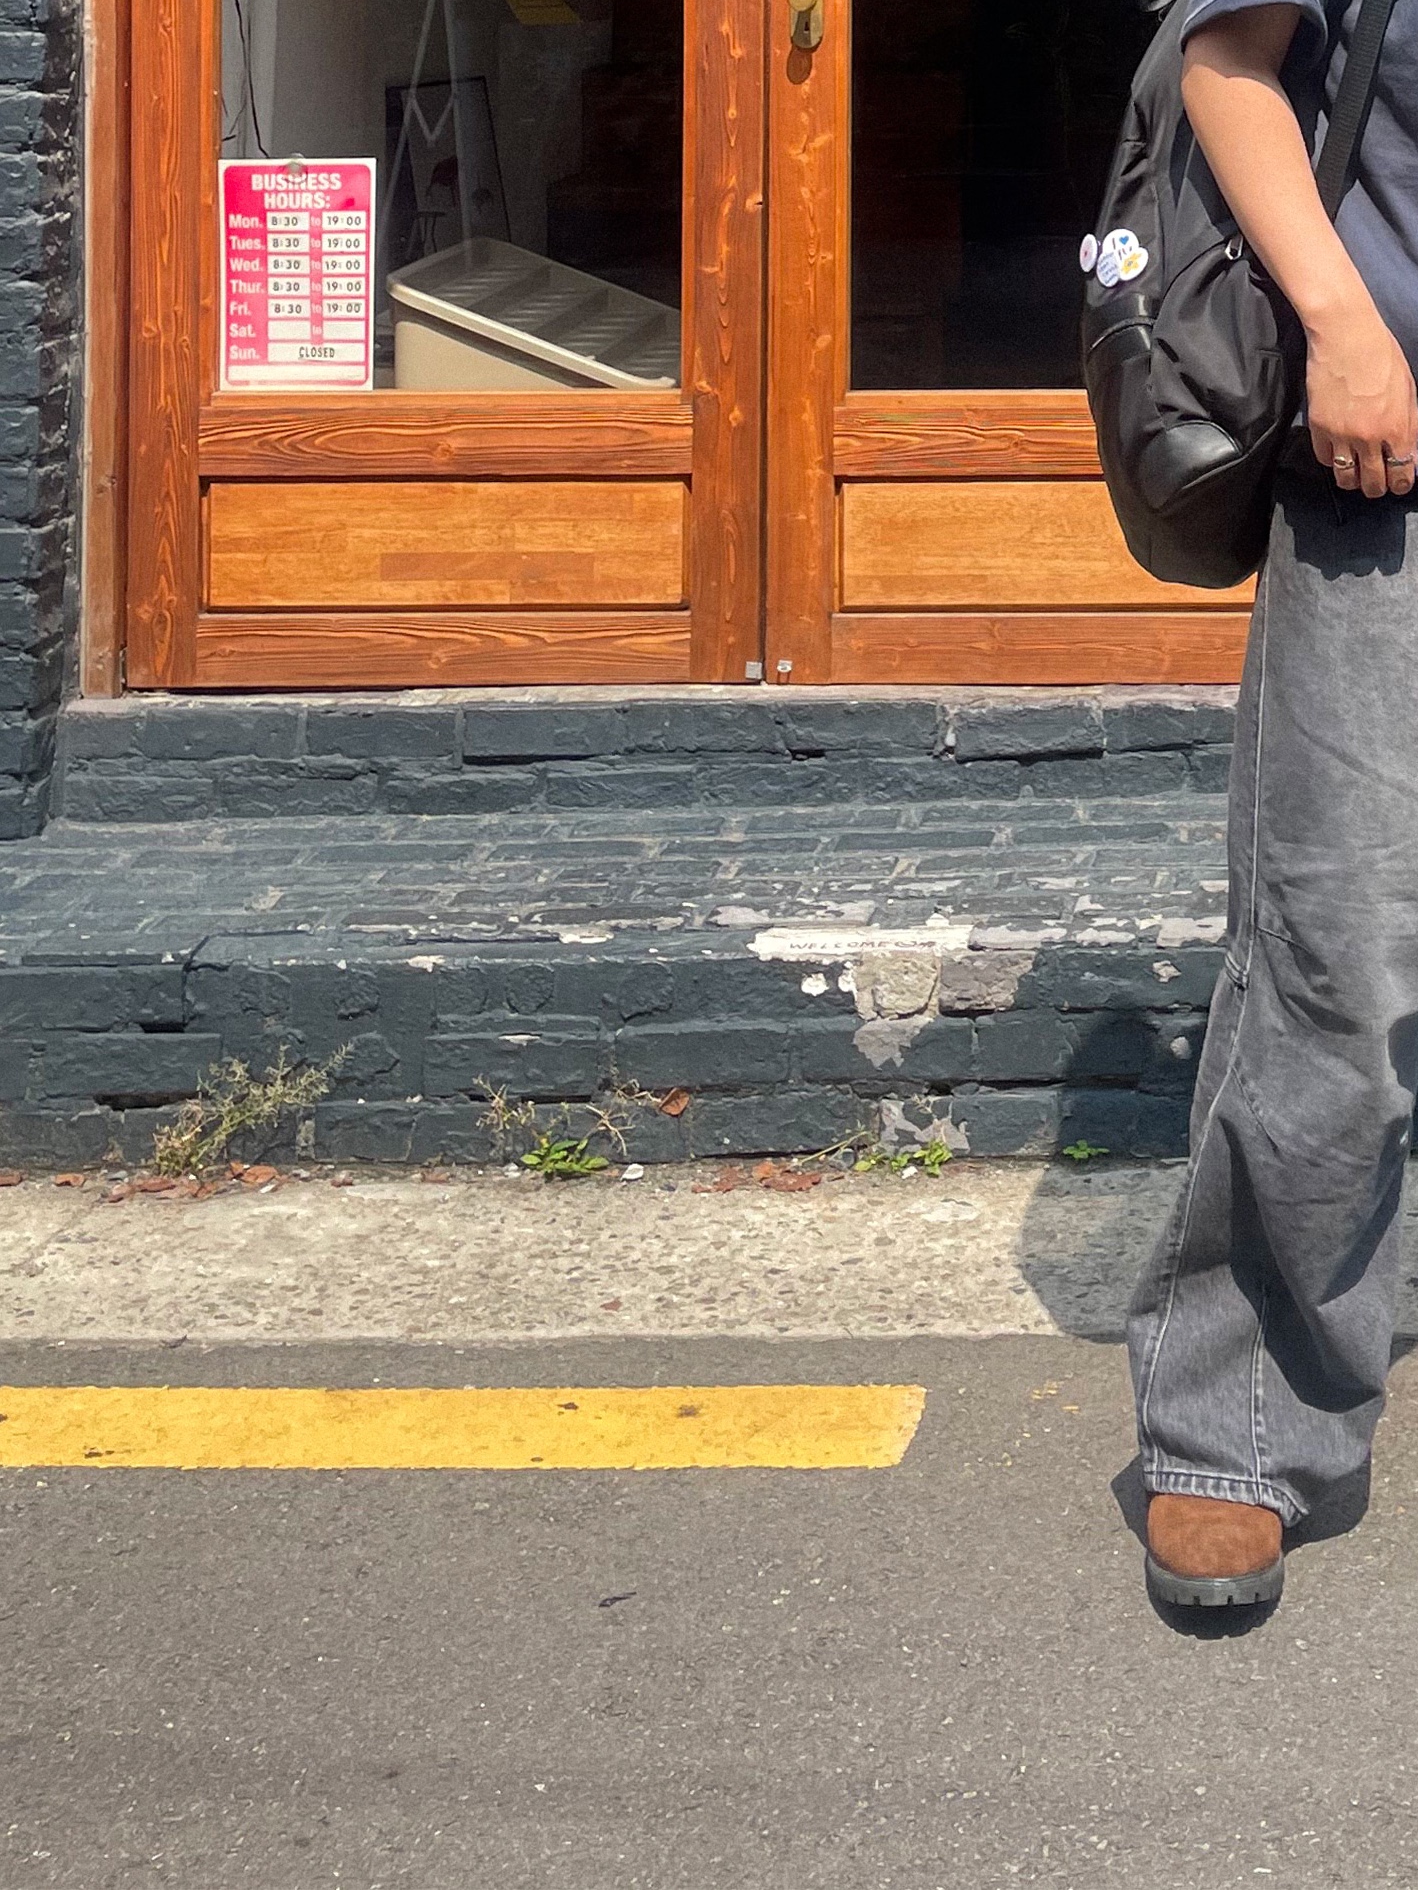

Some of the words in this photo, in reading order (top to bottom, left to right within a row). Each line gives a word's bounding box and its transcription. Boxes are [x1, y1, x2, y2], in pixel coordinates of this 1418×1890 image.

[251, 172, 342, 191] BUSINESS
[264, 192, 331, 210] HOURS:
[229, 213, 264, 229] Mon.
[326, 216, 362, 226] 19:00
[229, 235, 265, 250] Tues.
[272, 238, 300, 248] 8:30
[327, 238, 361, 248] 19:00
[230, 258, 264, 272] Wed.
[273, 259, 300, 270] 8:30
[325, 259, 361, 270] 19:00
[230, 280, 265, 294] Thur.
[273, 282, 300, 292] 8:30
[326, 281, 362, 292] 19:00
[229, 302, 252, 316] Fri.
[274, 304, 302, 314] 8:30
[327, 303, 362, 314] 19:00
[229, 324, 256, 338] Sat.
[229, 345, 261, 360] Sun.
[298, 346, 336, 359] CLOSED
[789, 940, 889, 951] WELCOME
